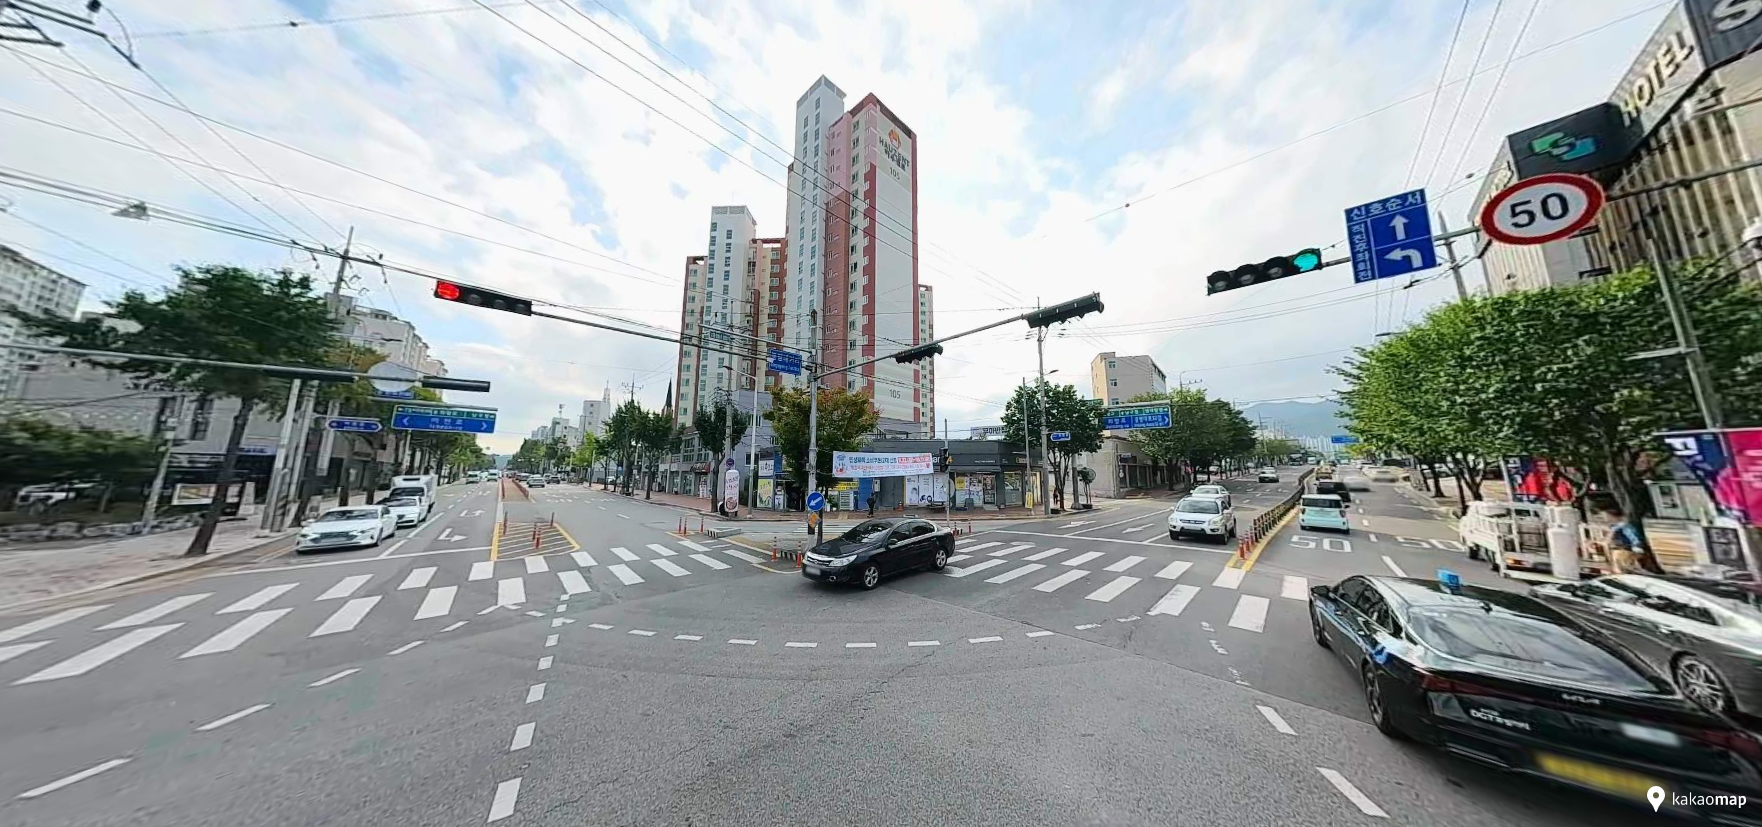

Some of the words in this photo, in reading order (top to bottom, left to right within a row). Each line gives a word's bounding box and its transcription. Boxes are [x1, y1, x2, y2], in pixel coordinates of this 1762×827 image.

[1620, 30, 1694, 127] HOTEL
[890, 167, 900, 180] 105
[1350, 191, 1422, 221] 신호순서
[1510, 192, 1570, 228] 50
[889, 389, 901, 399] 105
[1289, 535, 1352, 552] 50
[1396, 536, 1466, 552] 50
